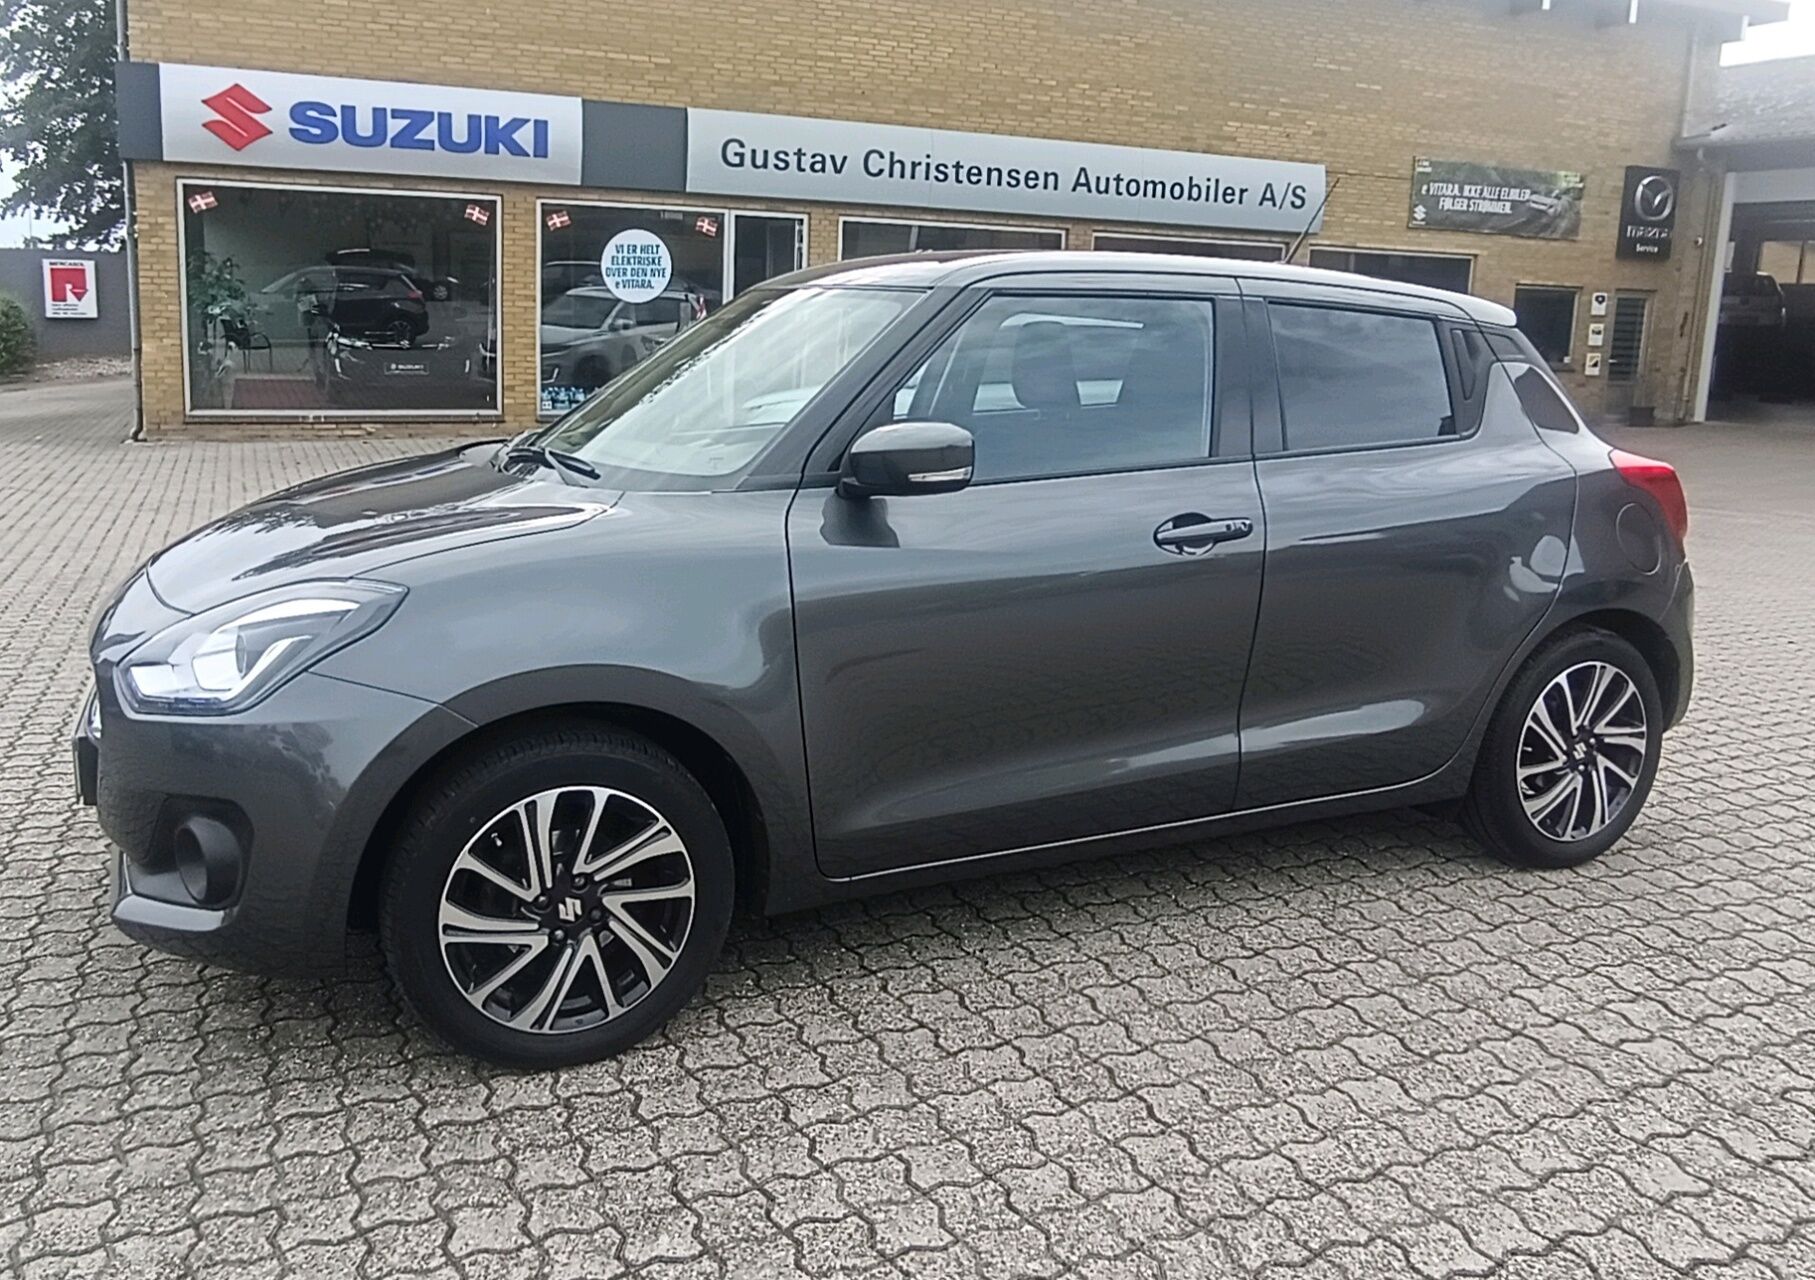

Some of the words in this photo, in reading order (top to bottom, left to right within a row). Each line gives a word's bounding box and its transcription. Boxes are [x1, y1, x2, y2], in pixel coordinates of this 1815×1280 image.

[288, 100, 549, 159] SUZUKI
[720, 137, 848, 175] Gustav
[862, 148, 1060, 192] Christensen
[1071, 166, 1249, 206] Automobiler
[1258, 181, 1307, 211] A/S
[1482, 186, 1501, 199] ALLE
[615, 244, 624, 254] VI
[627, 244, 637, 254] ER
[640, 244, 660, 255] HELT
[611, 255, 662, 266] ELEKTRISKE
[605, 267, 628, 278] OVER
[630, 267, 648, 278] DEN
[650, 267, 667, 278] NYE
[615, 281, 620, 289] e
[621, 279, 655, 289] VITARA.
